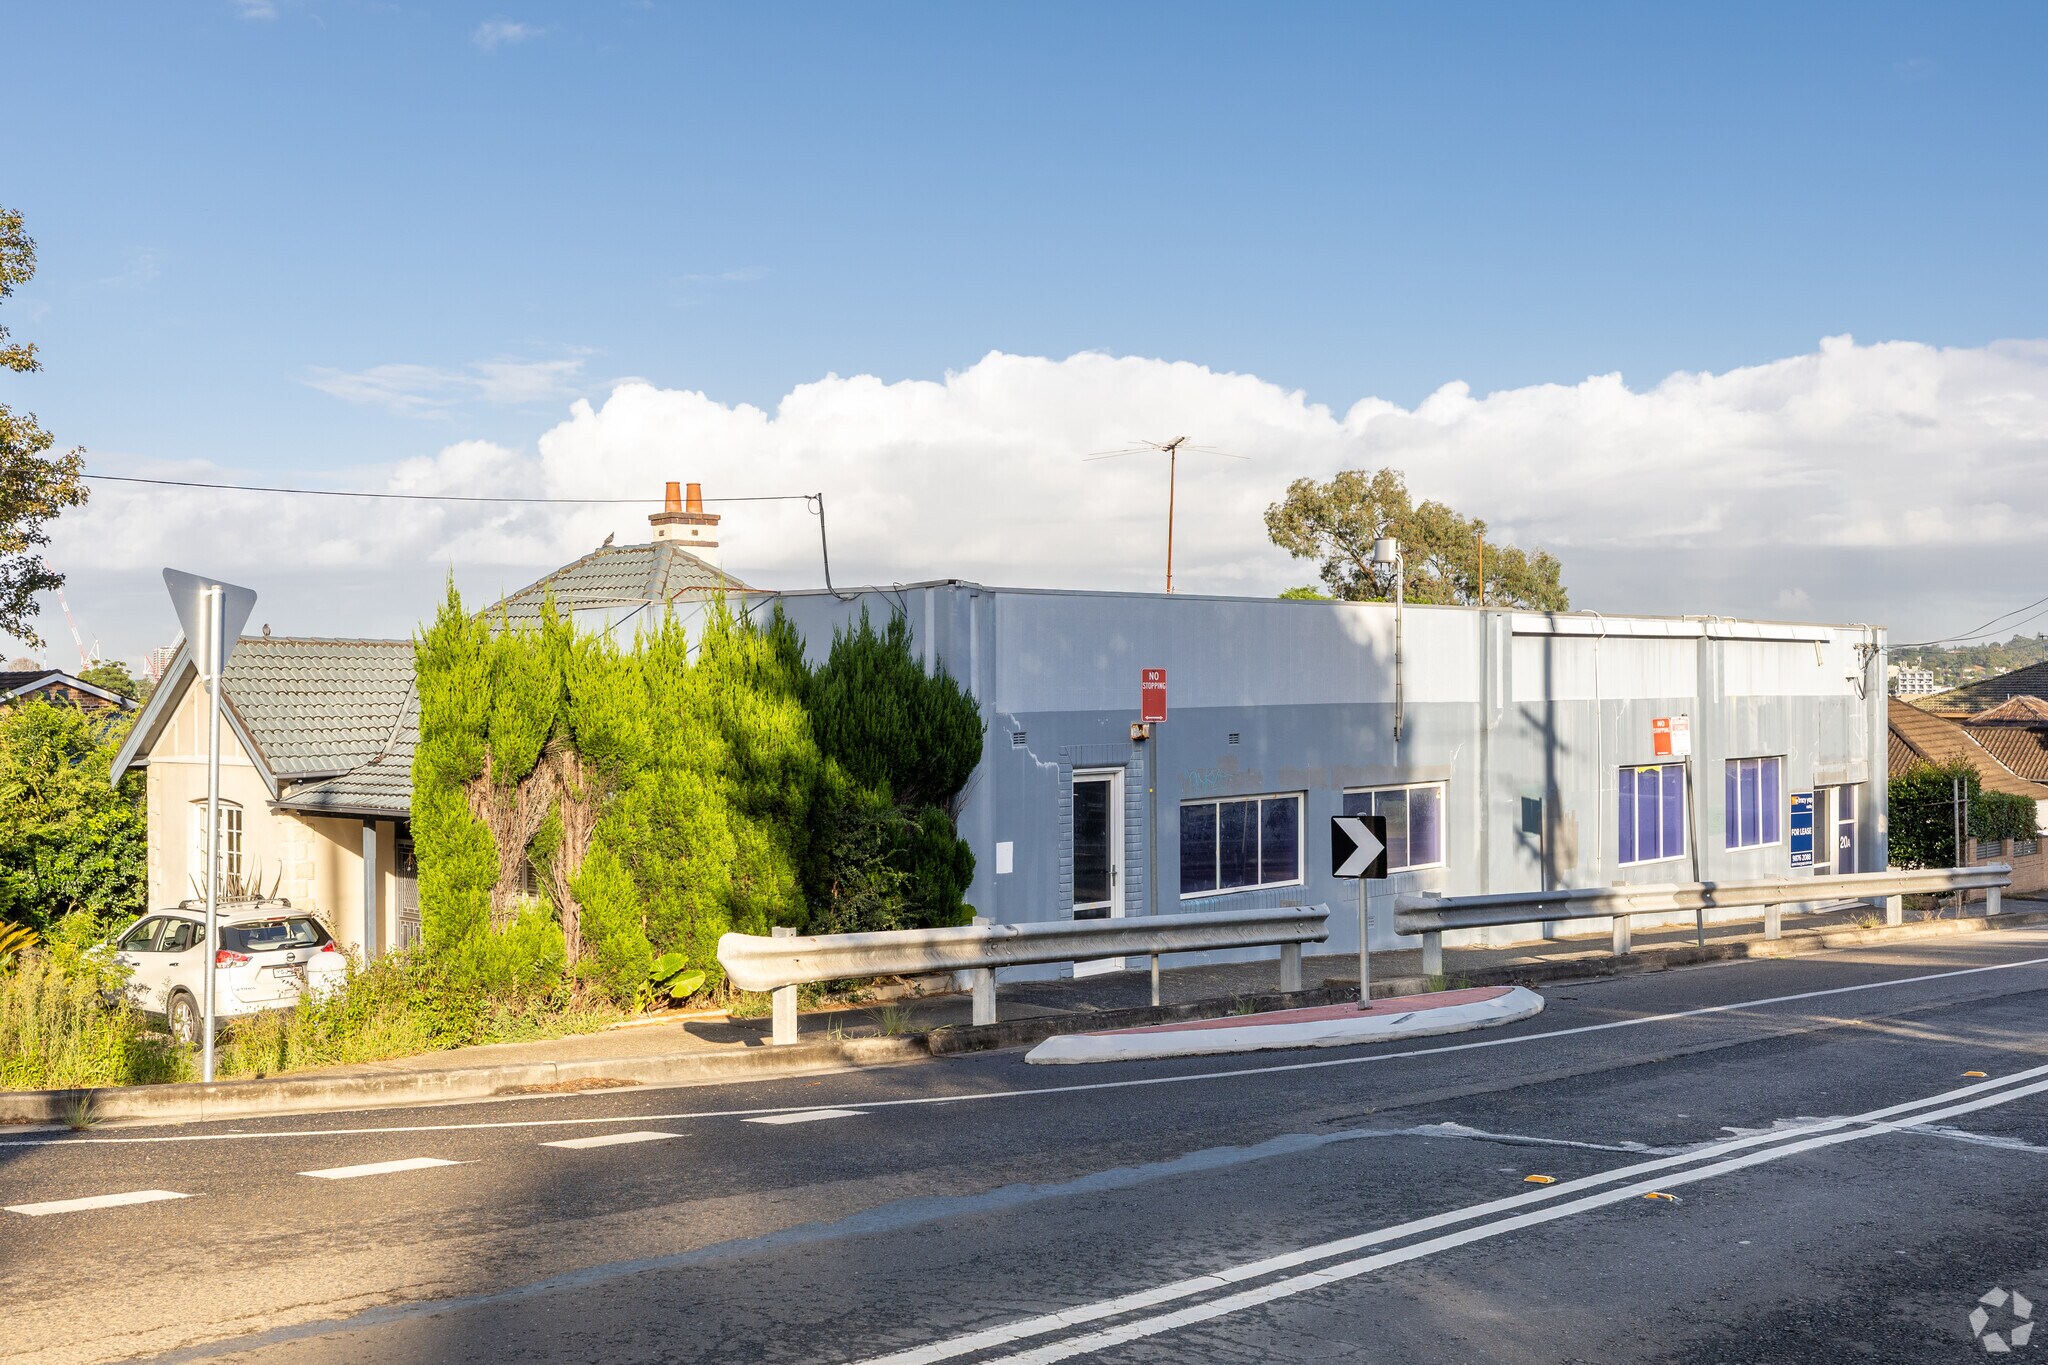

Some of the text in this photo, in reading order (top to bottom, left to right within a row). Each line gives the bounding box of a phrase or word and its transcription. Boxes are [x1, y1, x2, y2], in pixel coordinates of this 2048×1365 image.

[1148, 671, 1160, 681] NO
[1142, 682, 1166, 690] STOPPING
[1656, 720, 1666, 728] NO
[1791, 827, 1812, 836] FOR LEASE
[1840, 835, 1851, 849] 20A
